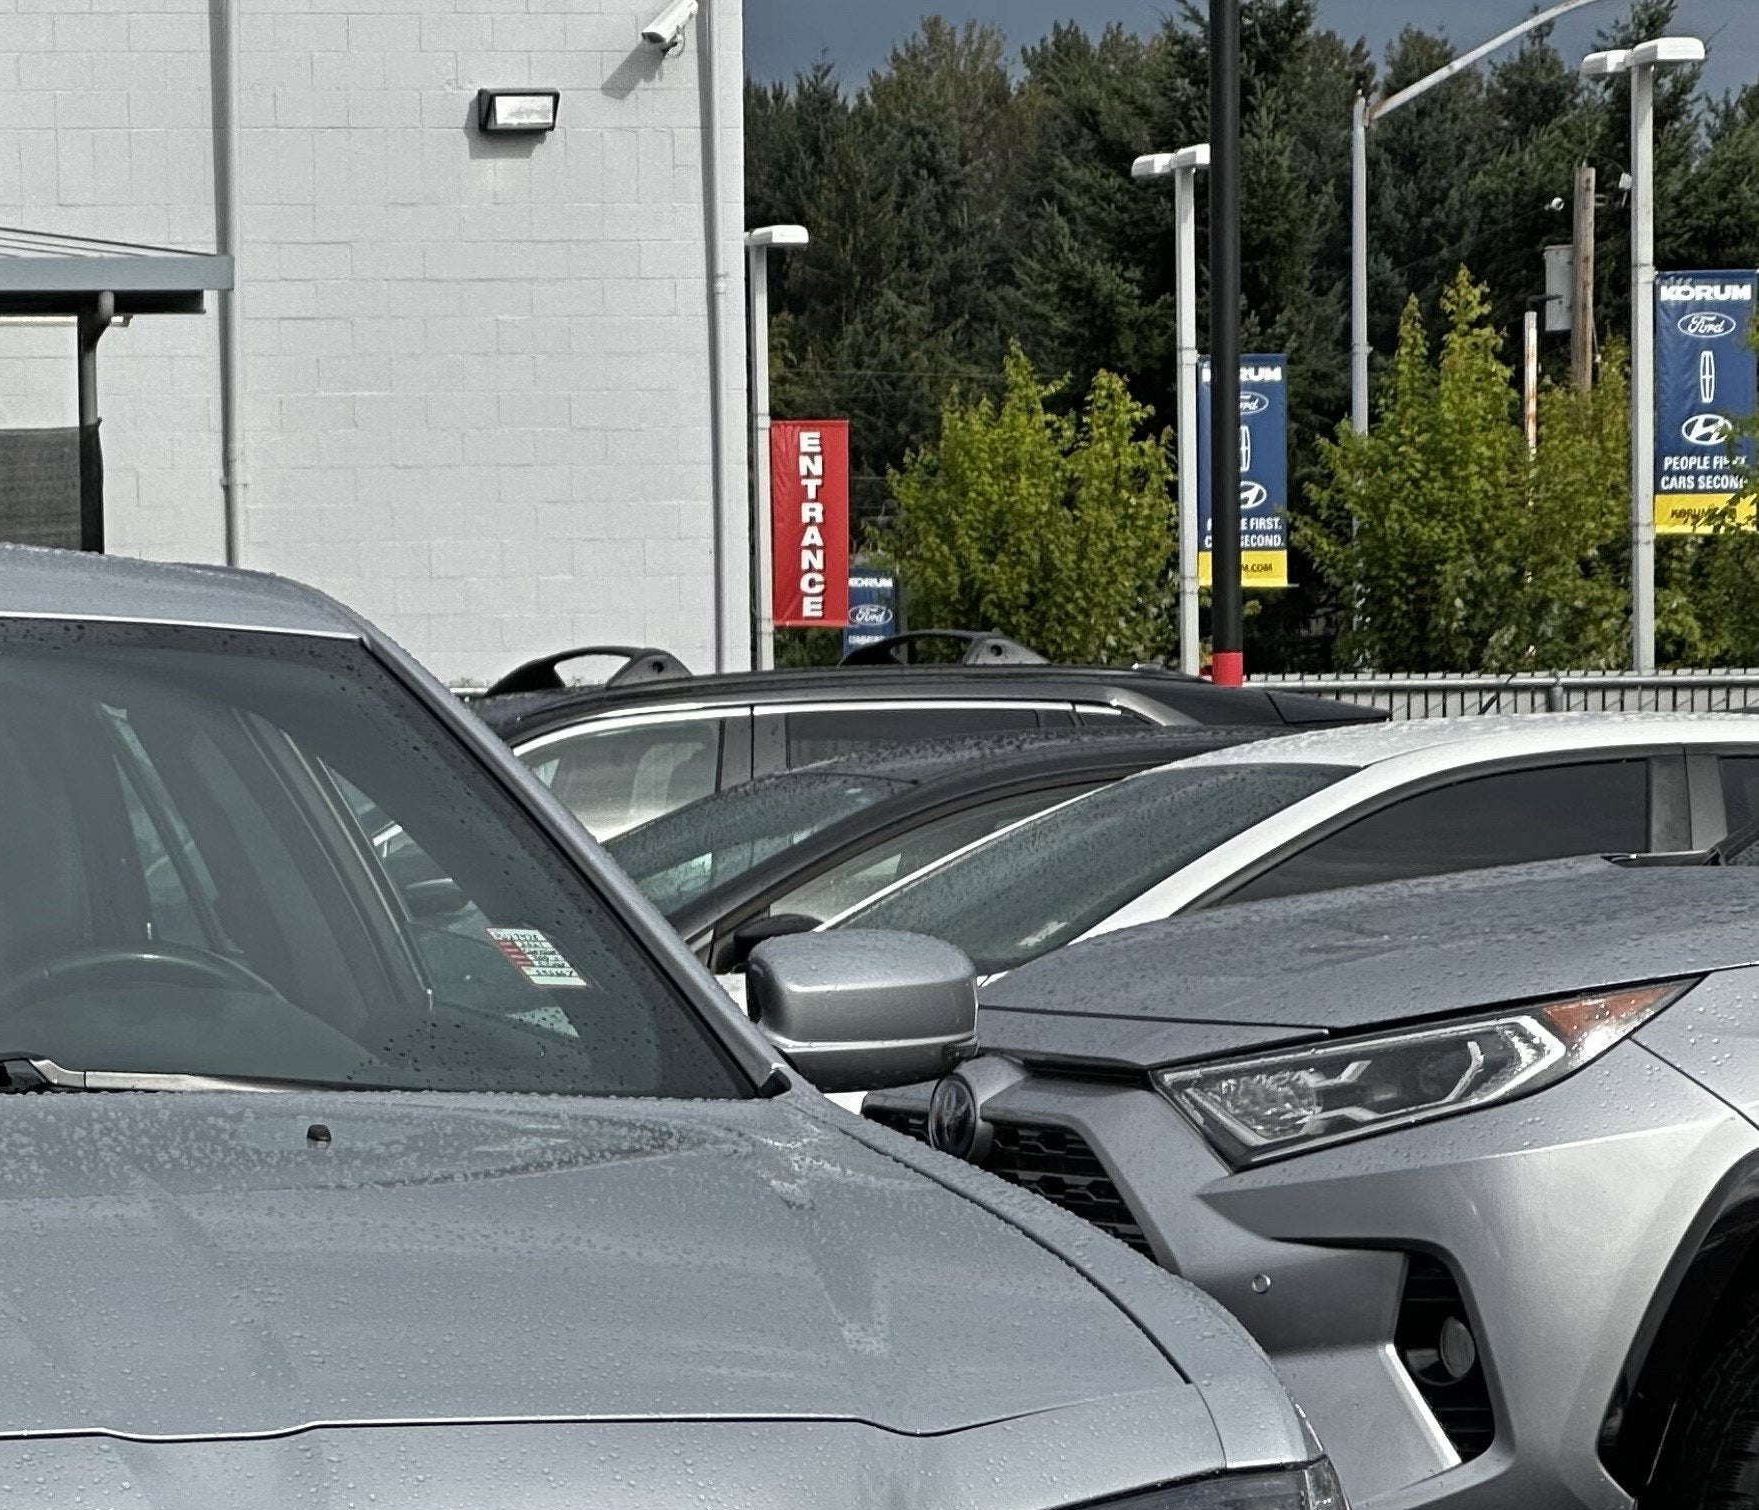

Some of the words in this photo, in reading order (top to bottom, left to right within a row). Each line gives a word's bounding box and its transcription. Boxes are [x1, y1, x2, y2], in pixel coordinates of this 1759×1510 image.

[1660, 284, 1752, 301] KORUM
[1663, 456, 1711, 471] PEOPLE
[1660, 475, 1695, 490] CARS
[798, 431, 826, 618] ENTRANCE
[1249, 517, 1282, 530] FIRST.
